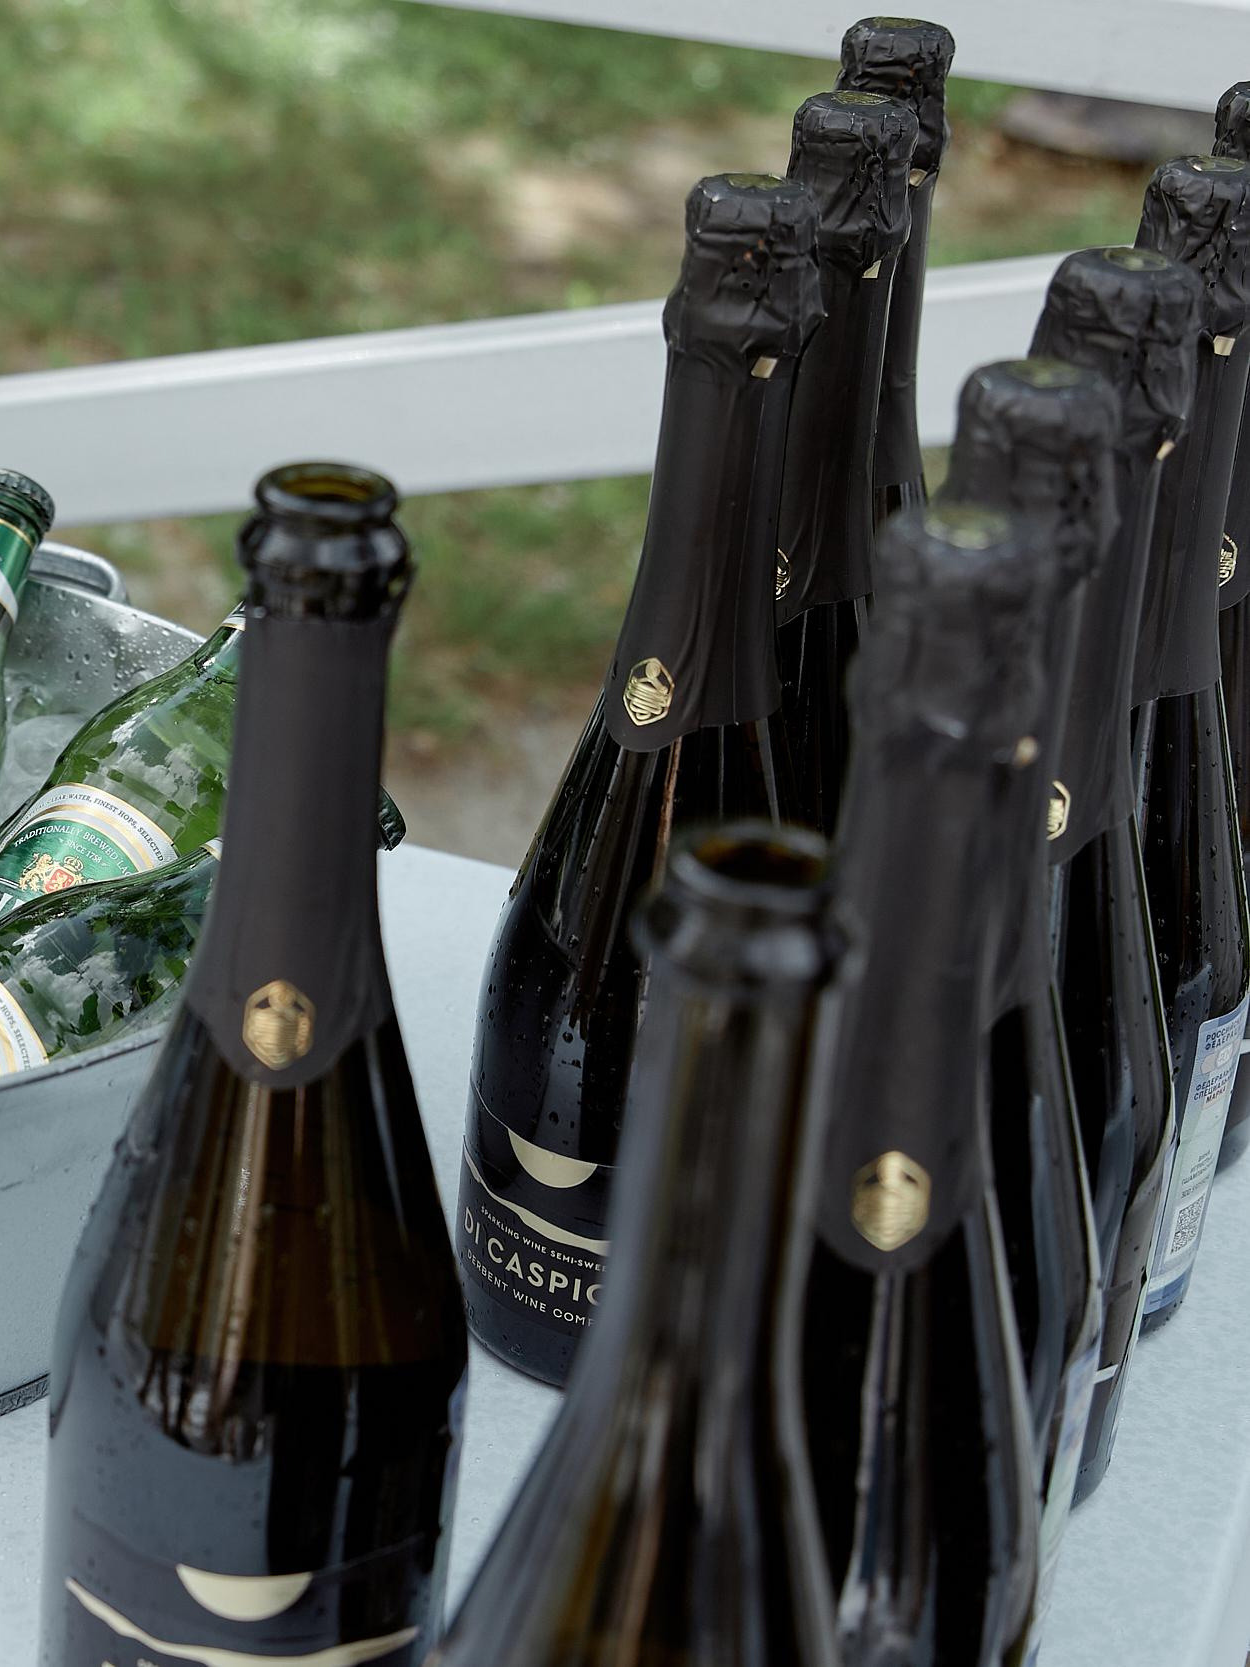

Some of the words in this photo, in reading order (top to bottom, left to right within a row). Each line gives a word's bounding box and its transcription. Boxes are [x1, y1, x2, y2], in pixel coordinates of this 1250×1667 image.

[13, 824, 82, 849] TRADITIONALLY
[82, 831, 119, 861] BREWED
[66, 839, 86, 855] SINCE
[94, 798, 120, 813] FINEST
[118, 810, 138, 829] HOPS,
[137, 827, 165, 862] SELECTED
[464, 1207, 481, 1244] DI
[481, 1206, 520, 1240] SPARKLING
[522, 1236, 547, 1254] WINE
[467, 1248, 509, 1292] DERBENT
[512, 1288, 547, 1313] WINE
